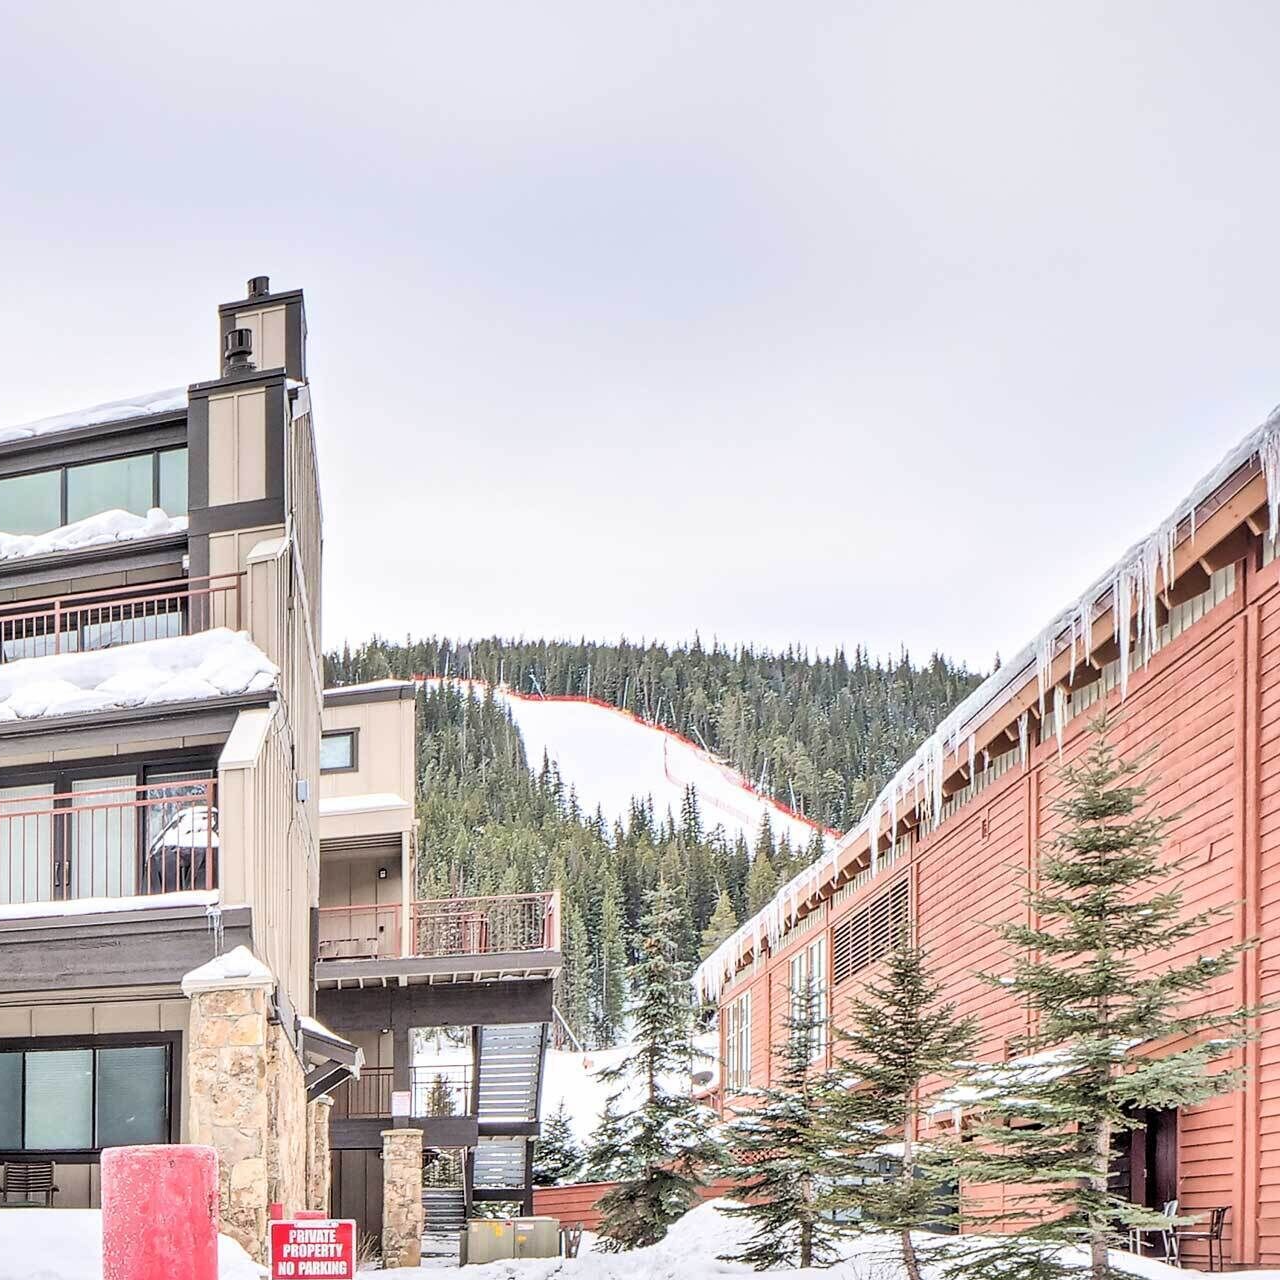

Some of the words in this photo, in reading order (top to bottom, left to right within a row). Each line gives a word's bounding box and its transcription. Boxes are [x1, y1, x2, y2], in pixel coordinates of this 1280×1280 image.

[289, 1229, 337, 1243] PRIVATE
[283, 1243, 344, 1258] PROPERTY
[278, 1261, 295, 1275] NO
[298, 1261, 347, 1275] PARKING
